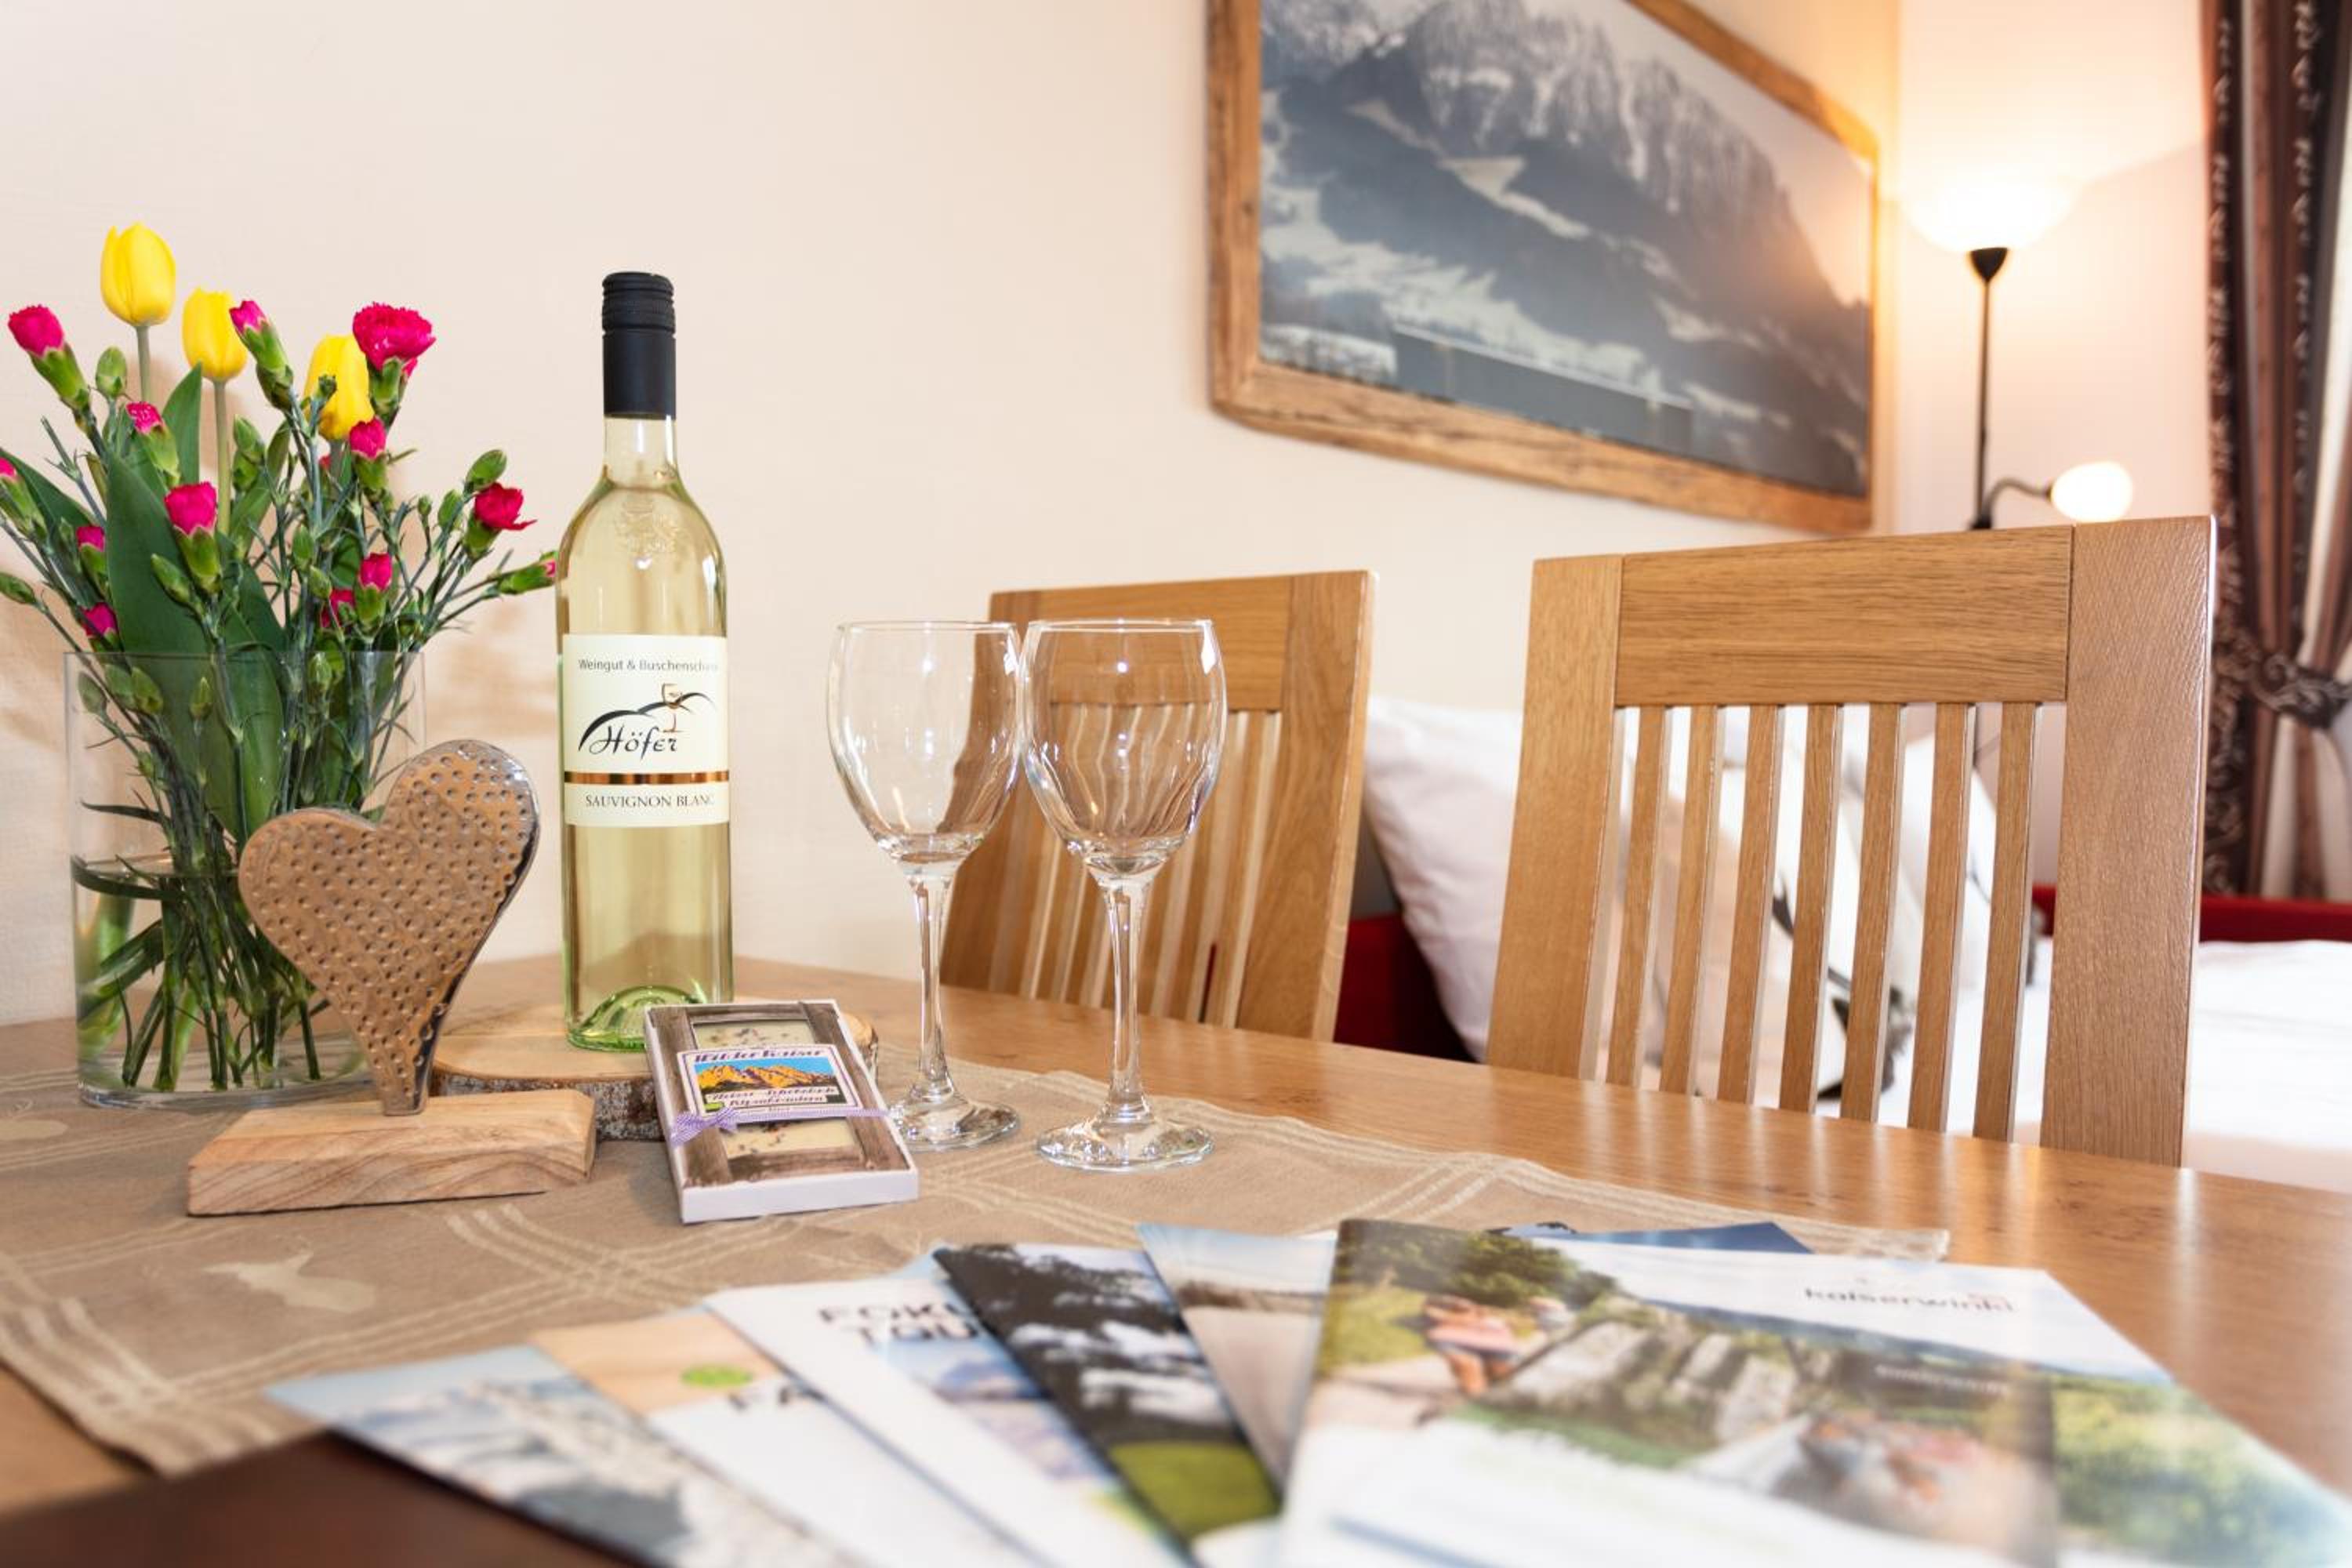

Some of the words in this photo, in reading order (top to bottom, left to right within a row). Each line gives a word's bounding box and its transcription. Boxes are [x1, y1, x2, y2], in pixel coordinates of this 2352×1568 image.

[579, 659, 623, 673] Weingut
[626, 660, 636, 671] &
[590, 724, 678, 760] Höfer
[585, 795, 673, 808] SAUVIGNON
